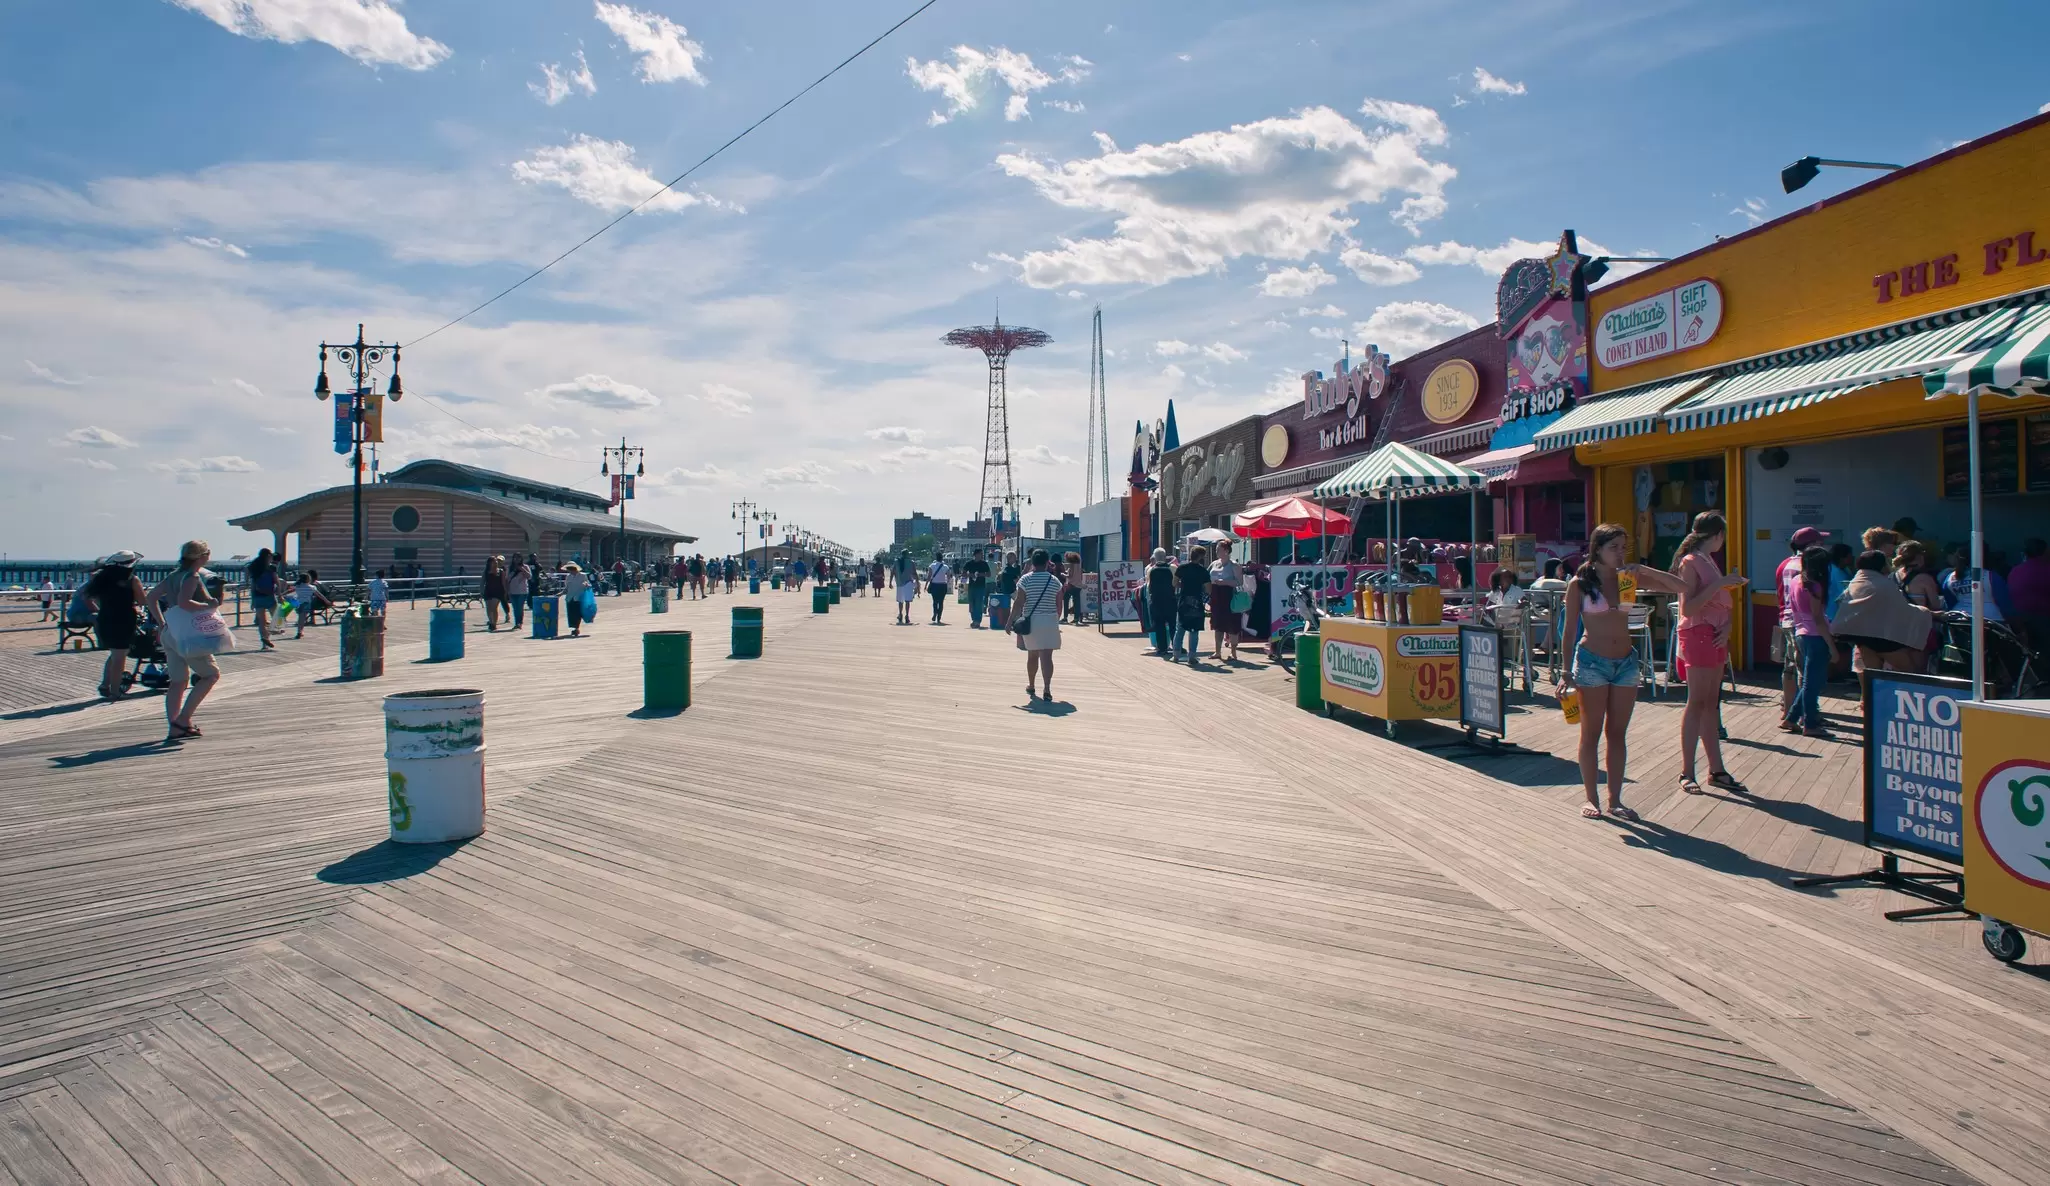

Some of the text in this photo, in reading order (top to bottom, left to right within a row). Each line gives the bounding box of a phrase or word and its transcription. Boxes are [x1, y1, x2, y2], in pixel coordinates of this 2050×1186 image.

[1873, 232, 2050, 304] THE FL
[1681, 284, 1706, 304] GIFT
[1605, 301, 1667, 334] Nathan's
[1681, 300, 1707, 317] SHOP
[1606, 332, 1667, 364] CONEY ISLAND
[1301, 344, 1386, 420] Ruby's
[1436, 371, 1460, 395] SINCE
[1439, 391, 1458, 412] 1934
[1530, 387, 1565, 415] SHOP
[1319, 429, 1334, 450] Bar
[1343, 415, 1366, 444] Grill
[1102, 580, 1138, 590] ICE
[1470, 636, 1492, 655] NO
[1327, 643, 1378, 680] Nathan's
[1419, 663, 1456, 700] 95
[1473, 708, 1493, 721] Point
[1476, 697, 1491, 710] This
[1895, 690, 1959, 726] NO
[1903, 797, 1953, 824] This
[1897, 816, 1959, 847] Point
